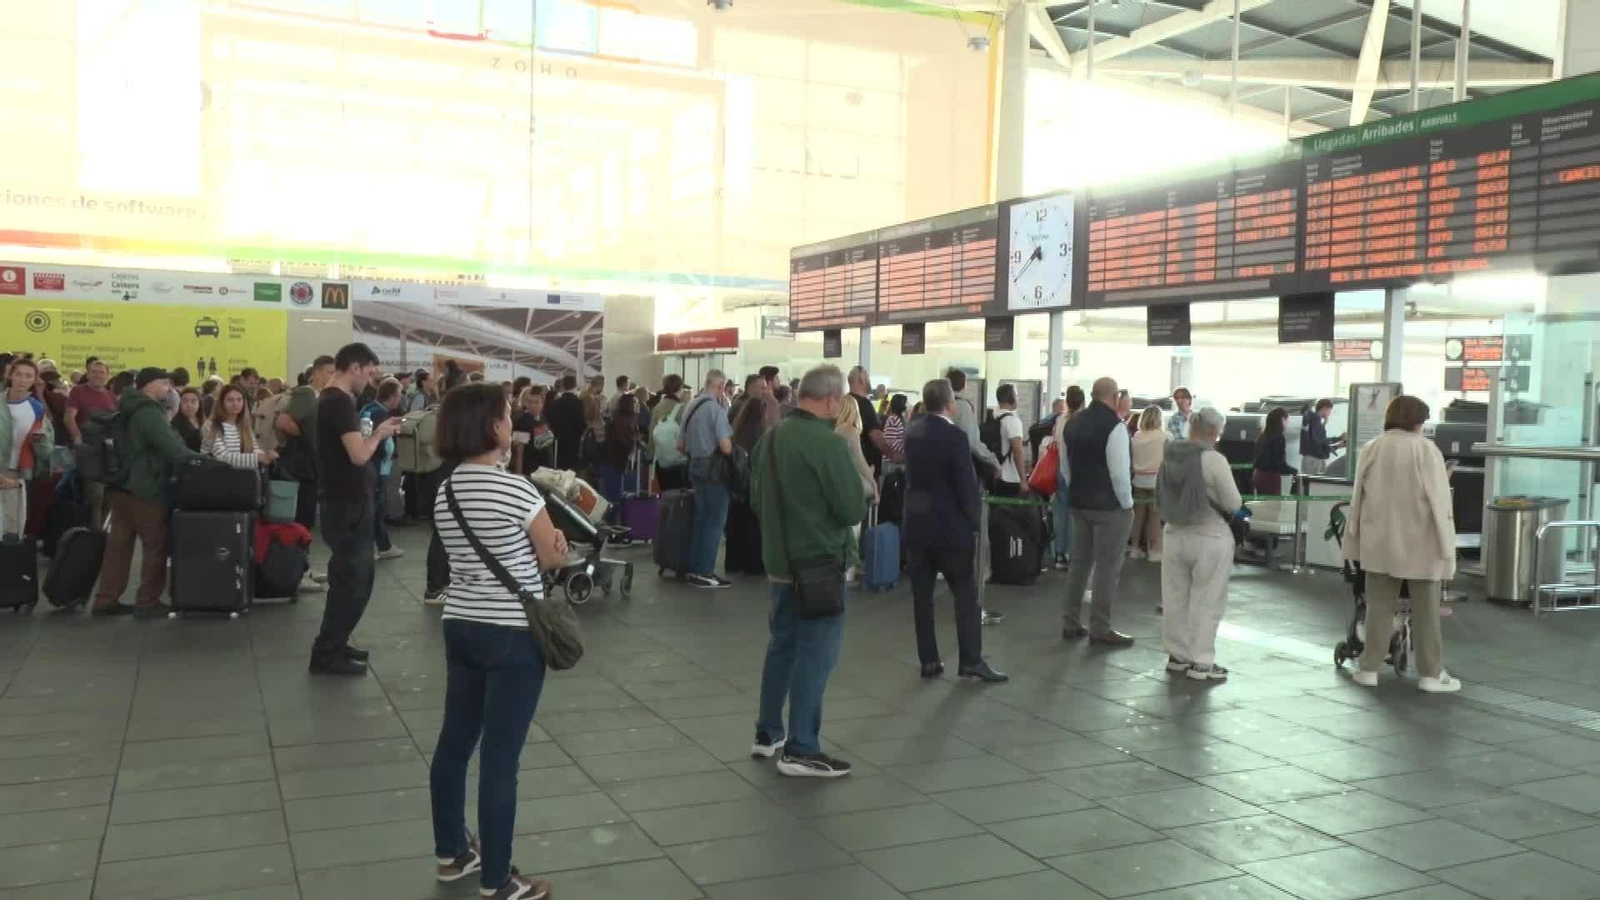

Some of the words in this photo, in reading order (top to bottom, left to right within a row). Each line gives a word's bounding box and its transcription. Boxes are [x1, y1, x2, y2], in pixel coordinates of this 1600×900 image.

[492, 56, 578, 79] ZOHO
[1314, 132, 1356, 152] Llegadas
[1361, 120, 1414, 141] Arribades
[1420, 112, 1456, 128] ARRIVALS
[72, 195, 98, 211] de
[104, 199, 197, 220] software
[1036, 208, 1047, 222] 12
[1013, 250, 1022, 264] 9
[1059, 243, 1068, 257] 3
[1034, 285, 1043, 300] 6
